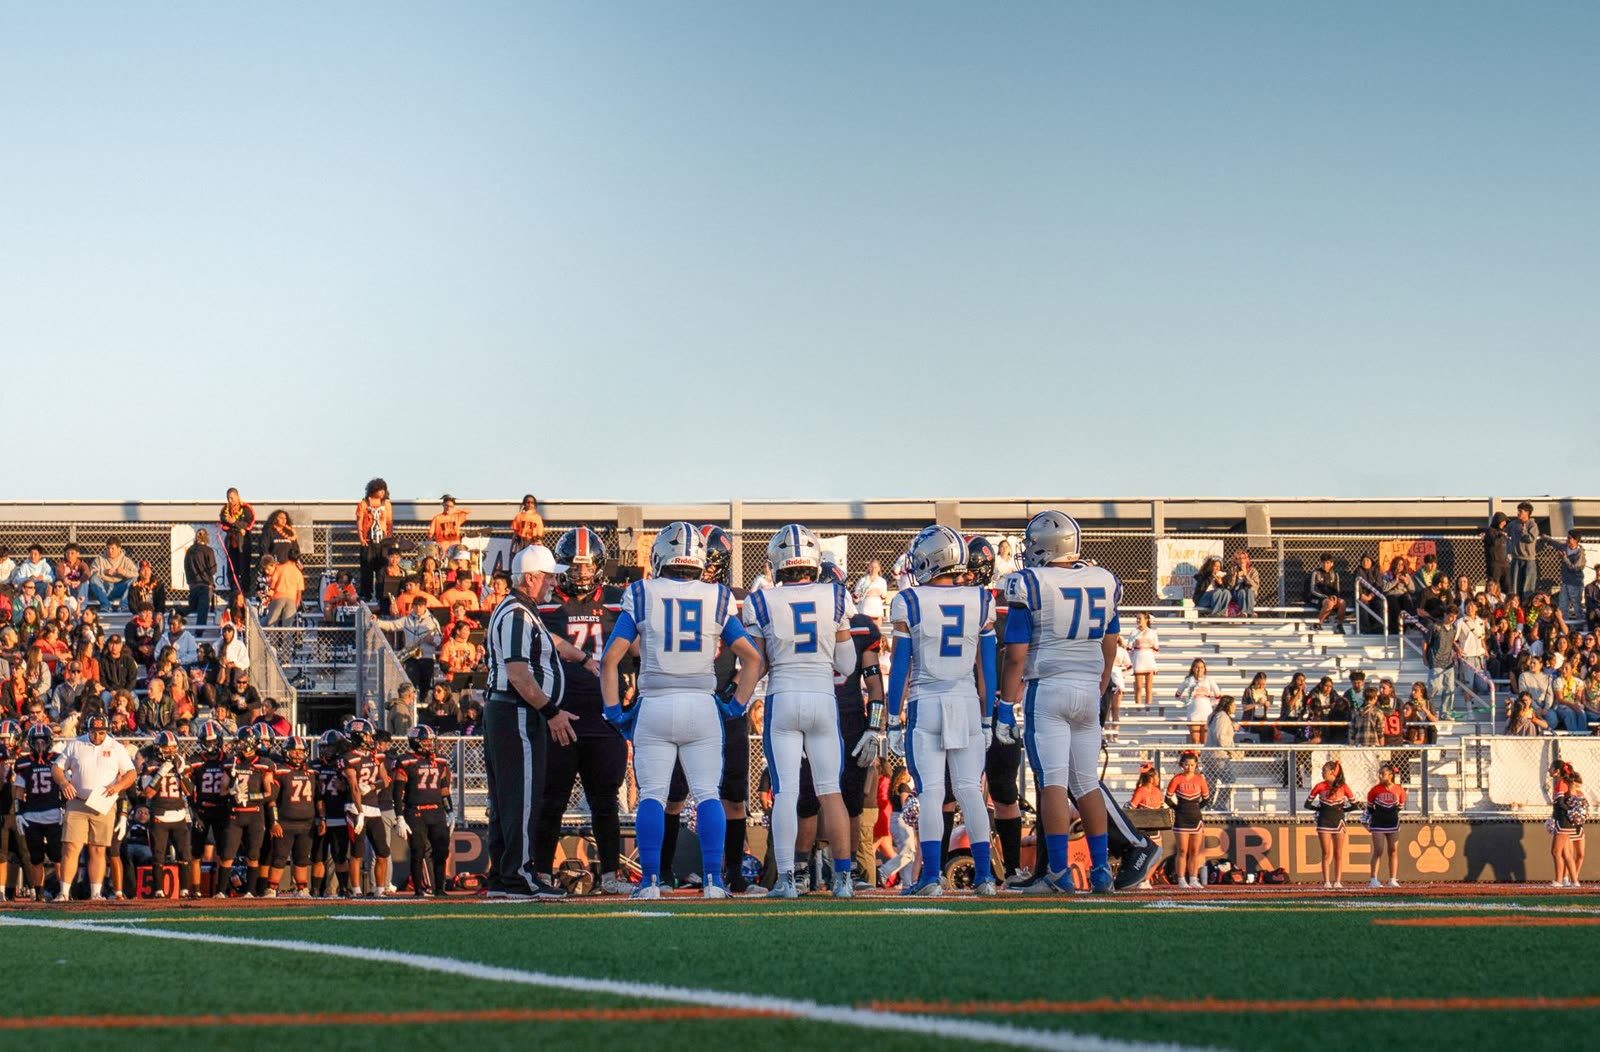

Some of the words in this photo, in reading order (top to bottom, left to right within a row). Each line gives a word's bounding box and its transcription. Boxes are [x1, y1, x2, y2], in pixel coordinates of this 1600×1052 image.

[674, 557, 699, 565] Riddell
[661, 598, 703, 652] 19
[1058, 587, 1106, 640] 75
[789, 601, 818, 654] 5
[939, 604, 965, 657] 2
[567, 623, 603, 661] 71
[31, 771, 52, 794] 15
[160, 775, 180, 798] 12
[202, 772, 224, 794] 22
[291, 780, 312, 802] 74
[418, 768, 439, 789] 77
[1133, 853, 1147, 870] HOKA
[1198, 826, 1372, 874] PRIDE
[141, 869, 174, 898] 50
